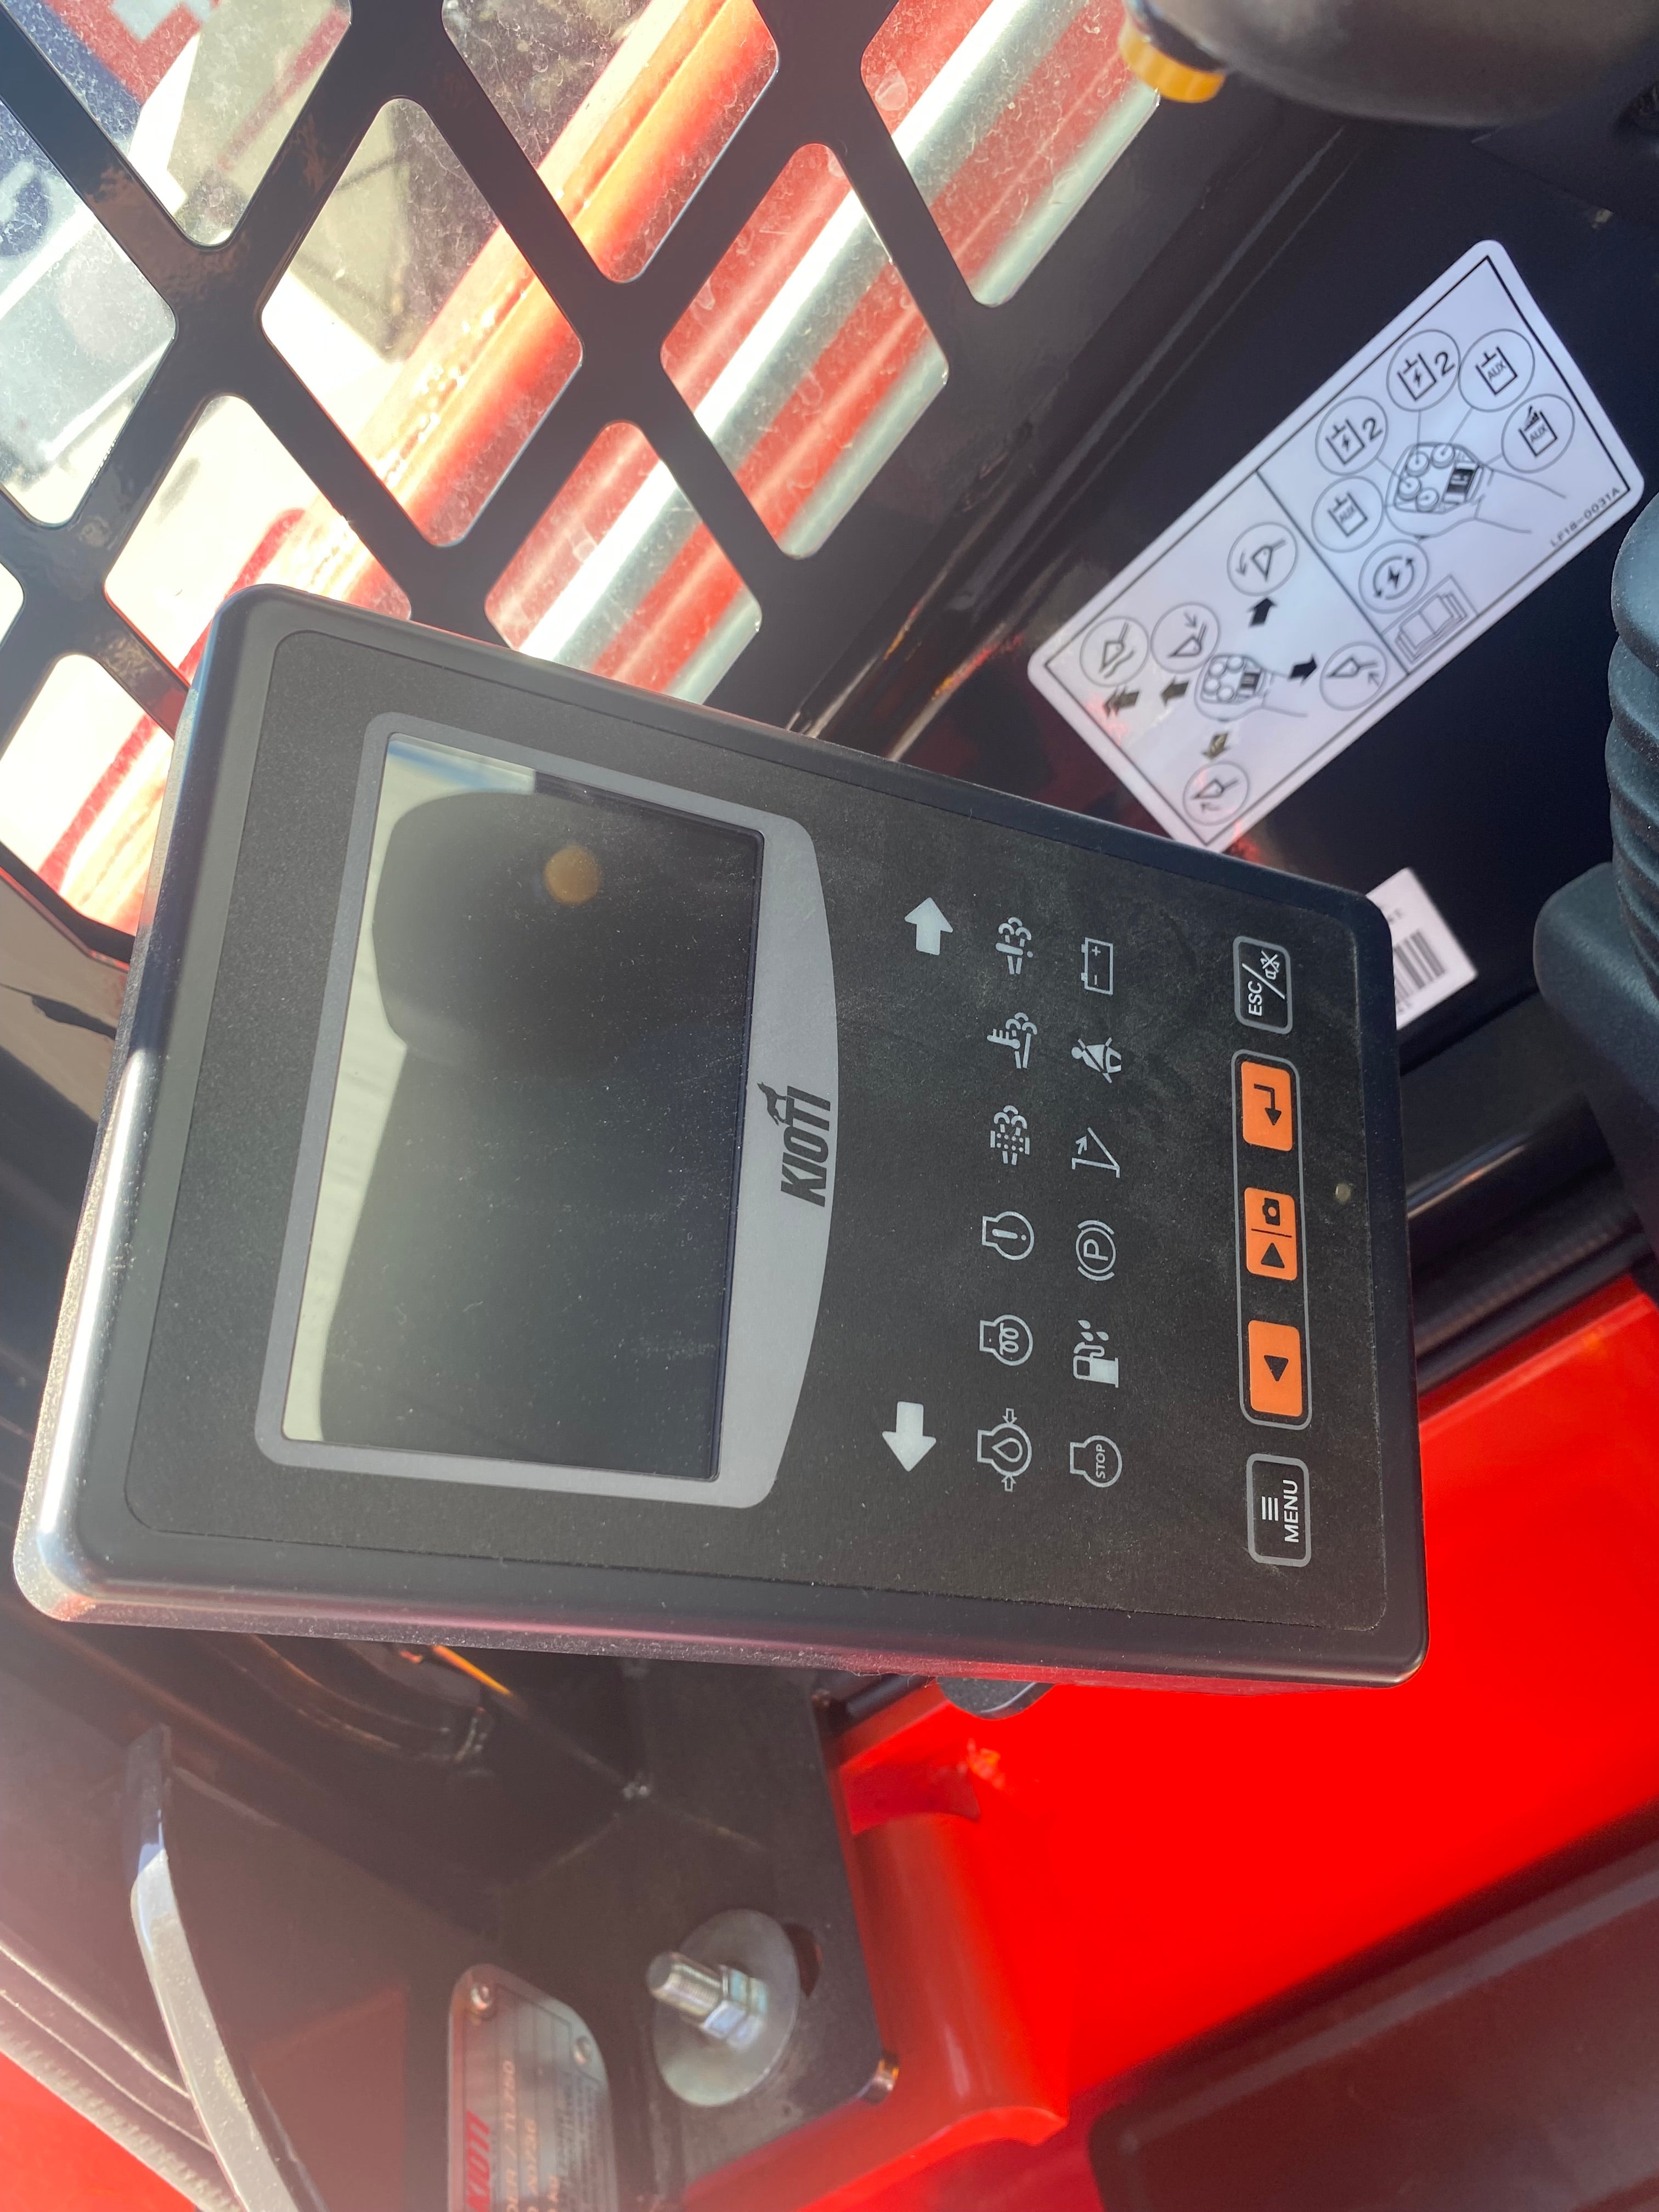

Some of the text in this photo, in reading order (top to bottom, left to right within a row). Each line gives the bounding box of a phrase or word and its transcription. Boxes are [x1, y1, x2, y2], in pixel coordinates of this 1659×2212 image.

[1434, 351, 1455, 376] 2
[1486, 360, 1507, 382] AUX
[1362, 417, 1384, 442] 2
[1529, 424, 1548, 444] AUX
[781, 1085, 831, 1207] KIOTI
[1083, 1238, 1108, 1261] P
[1095, 1443, 1105, 1479] STOP
[1283, 1479, 1299, 1543] MENU
